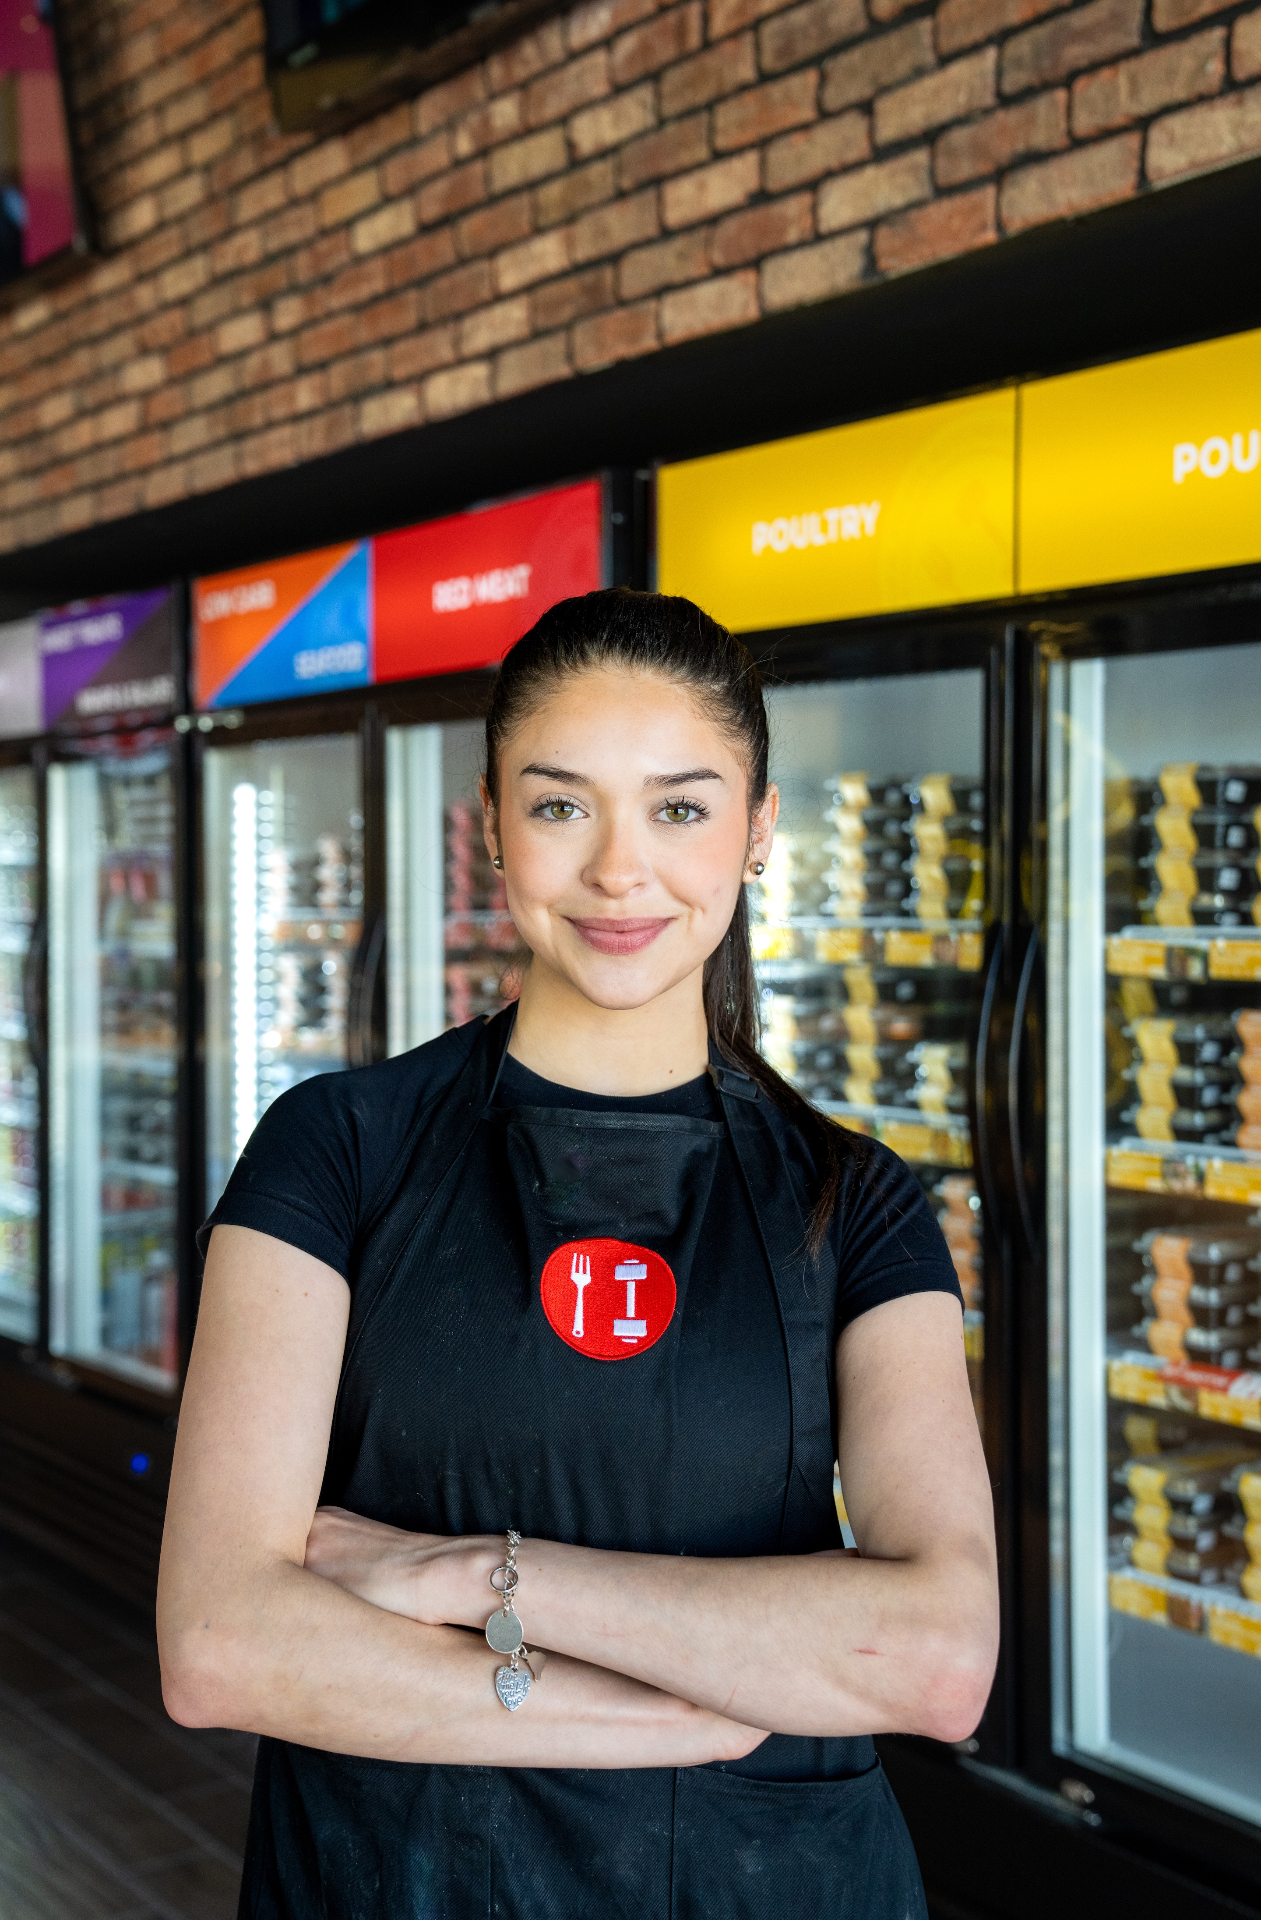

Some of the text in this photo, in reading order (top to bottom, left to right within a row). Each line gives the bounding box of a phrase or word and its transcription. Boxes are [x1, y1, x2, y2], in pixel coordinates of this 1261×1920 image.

[1173, 429, 1261, 485] POU
[752, 500, 882, 556] POULTRY
[432, 576, 472, 614] RED
